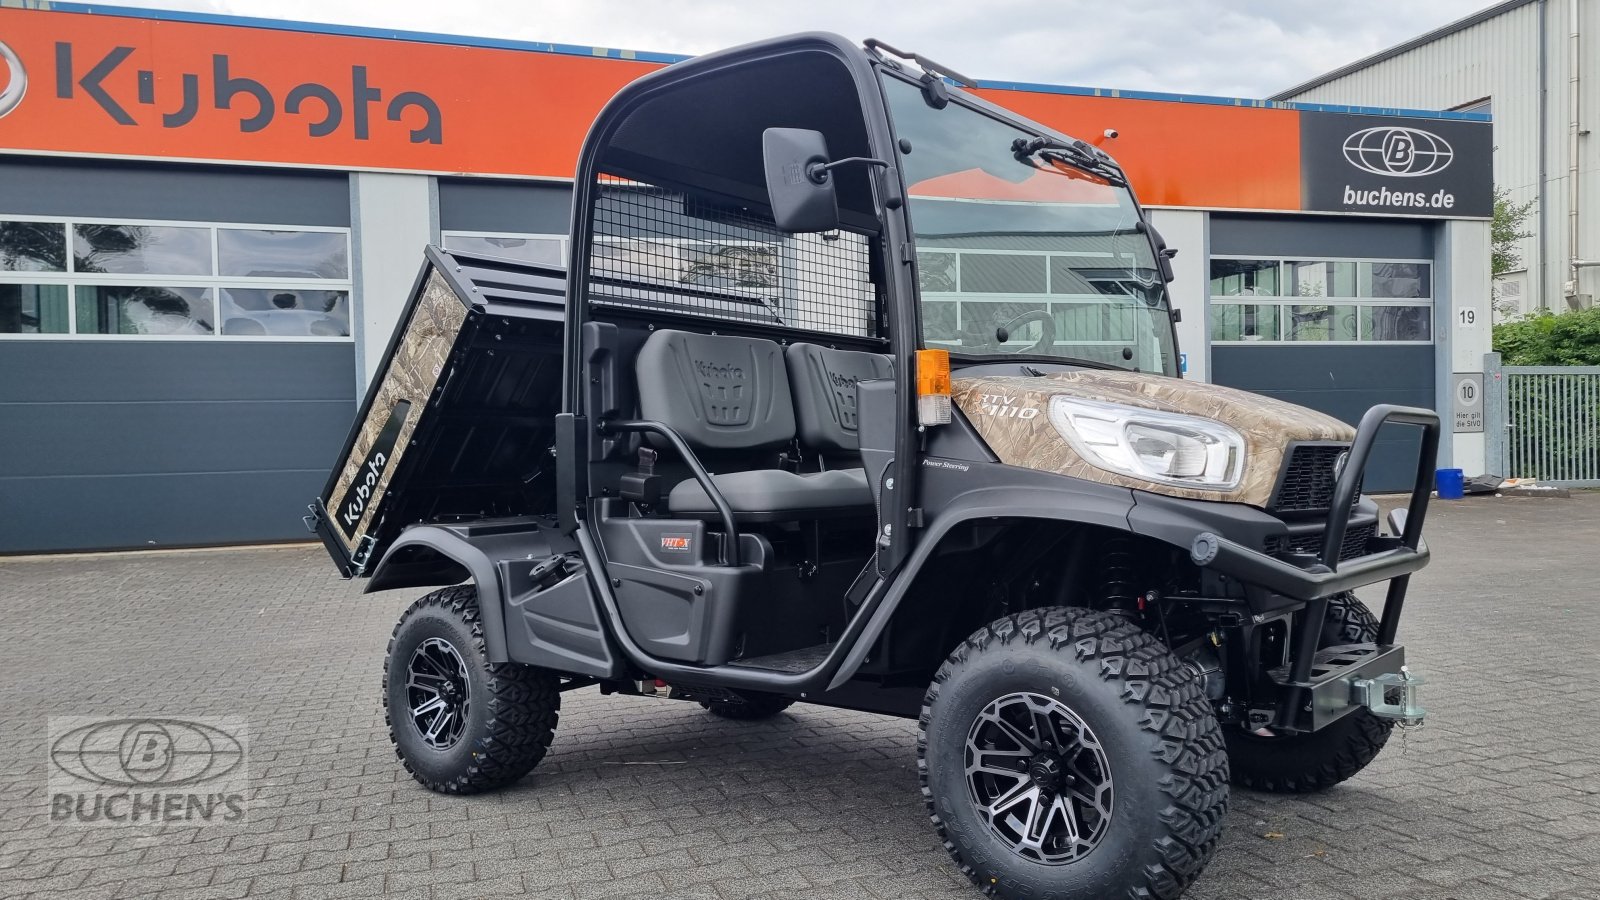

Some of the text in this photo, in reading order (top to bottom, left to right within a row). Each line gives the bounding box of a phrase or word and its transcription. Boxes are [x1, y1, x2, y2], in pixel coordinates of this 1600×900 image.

[55, 41, 443, 145] Kubota
[1386, 135, 1413, 165] B
[1343, 185, 1455, 208] buchens.de
[1459, 310, 1475, 324] 19
[694, 360, 745, 379] Kubota
[977, 393, 1017, 405] RTV
[1462, 386, 1474, 399] 10
[1471, 412, 1481, 420] gilt
[922, 459, 970, 472] Power Steering
[343, 452, 386, 526] Kubota
